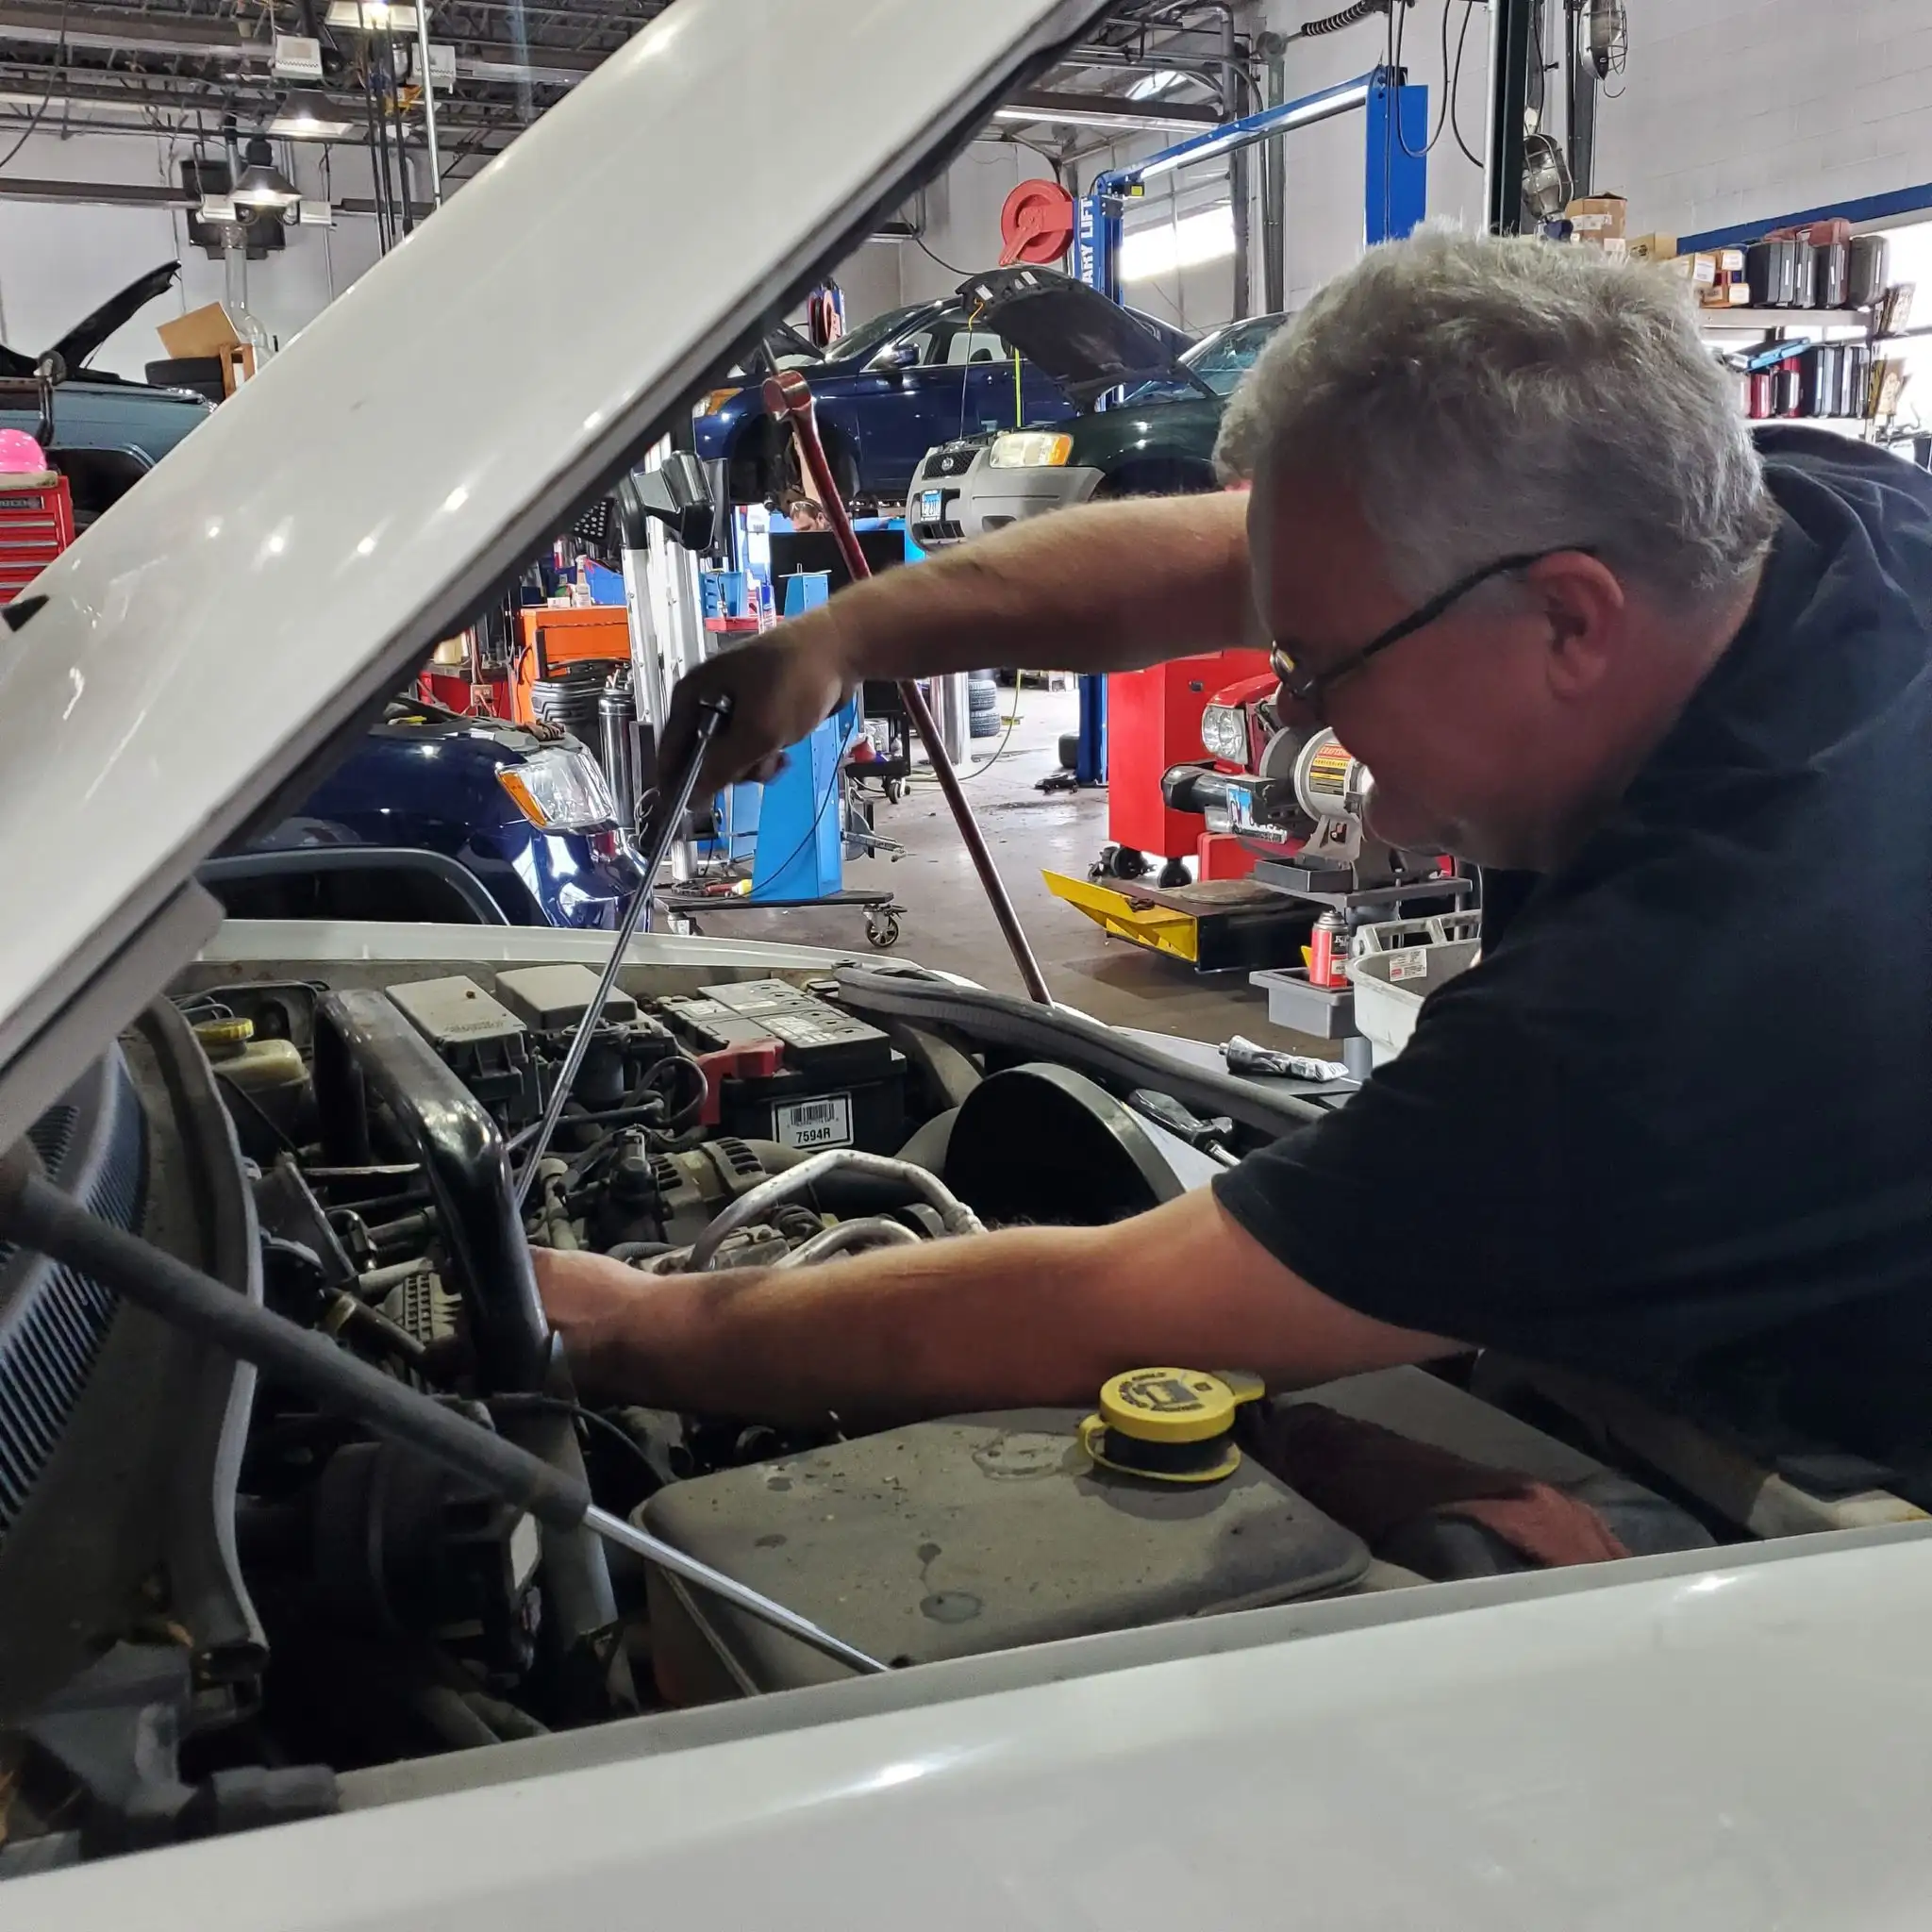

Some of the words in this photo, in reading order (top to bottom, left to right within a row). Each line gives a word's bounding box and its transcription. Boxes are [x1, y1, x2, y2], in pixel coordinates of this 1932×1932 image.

[1080, 196, 1093, 239] LIFT
[1081, 242, 1093, 288] ARY
[796, 1127, 831, 1143] 7594R
